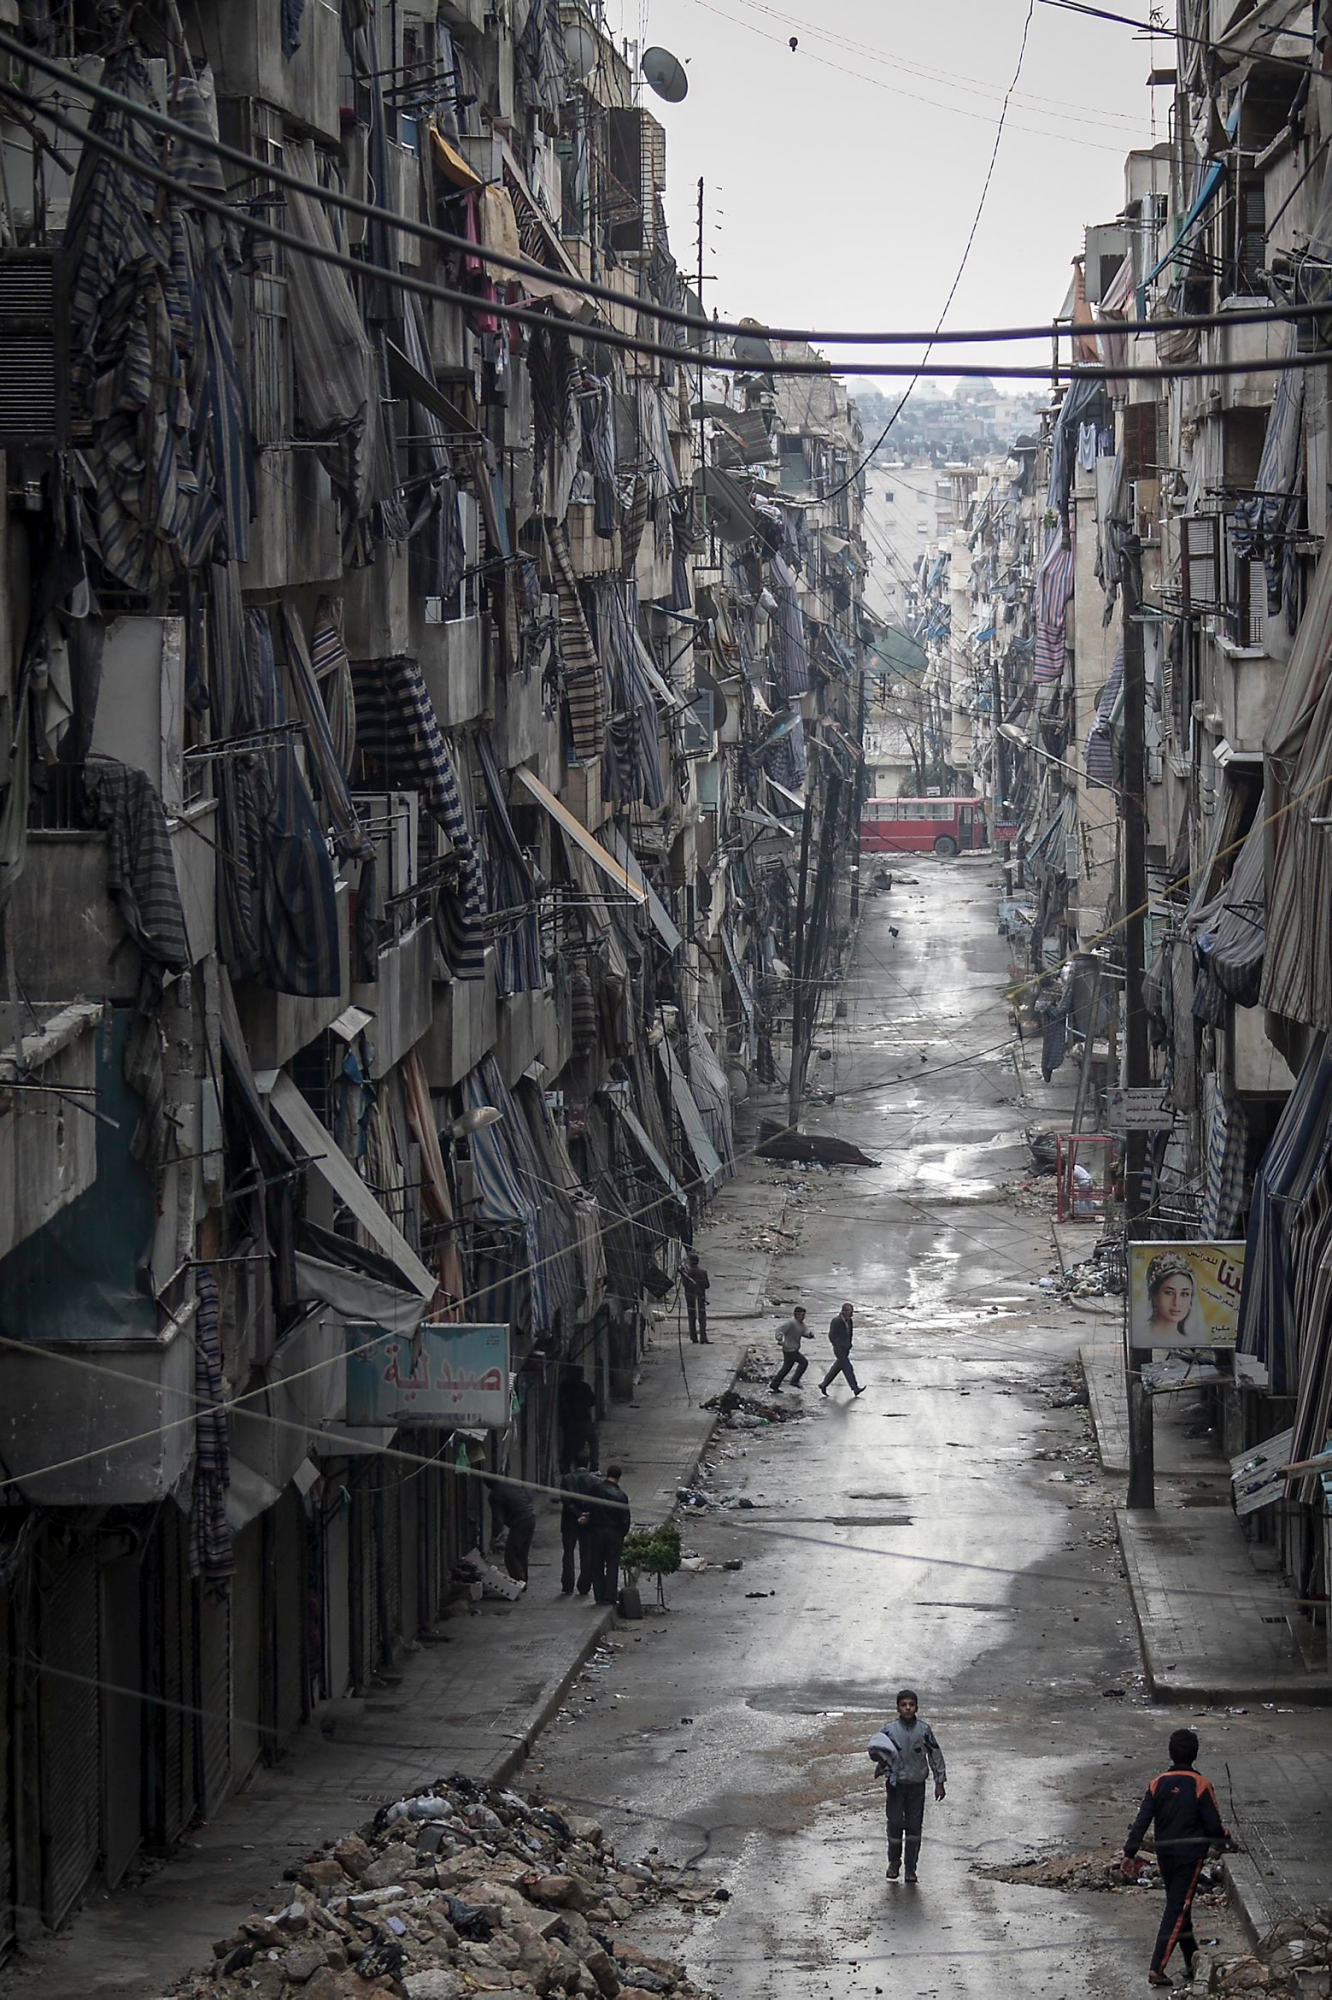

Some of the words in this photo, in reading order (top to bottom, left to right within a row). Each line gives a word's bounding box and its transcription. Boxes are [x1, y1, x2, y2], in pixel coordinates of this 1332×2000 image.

[1187, 1250, 1218, 1265] للعرائس
[1210, 1325, 1230, 1334] مكياج
[383, 1344, 502, 1403] صيدلية
